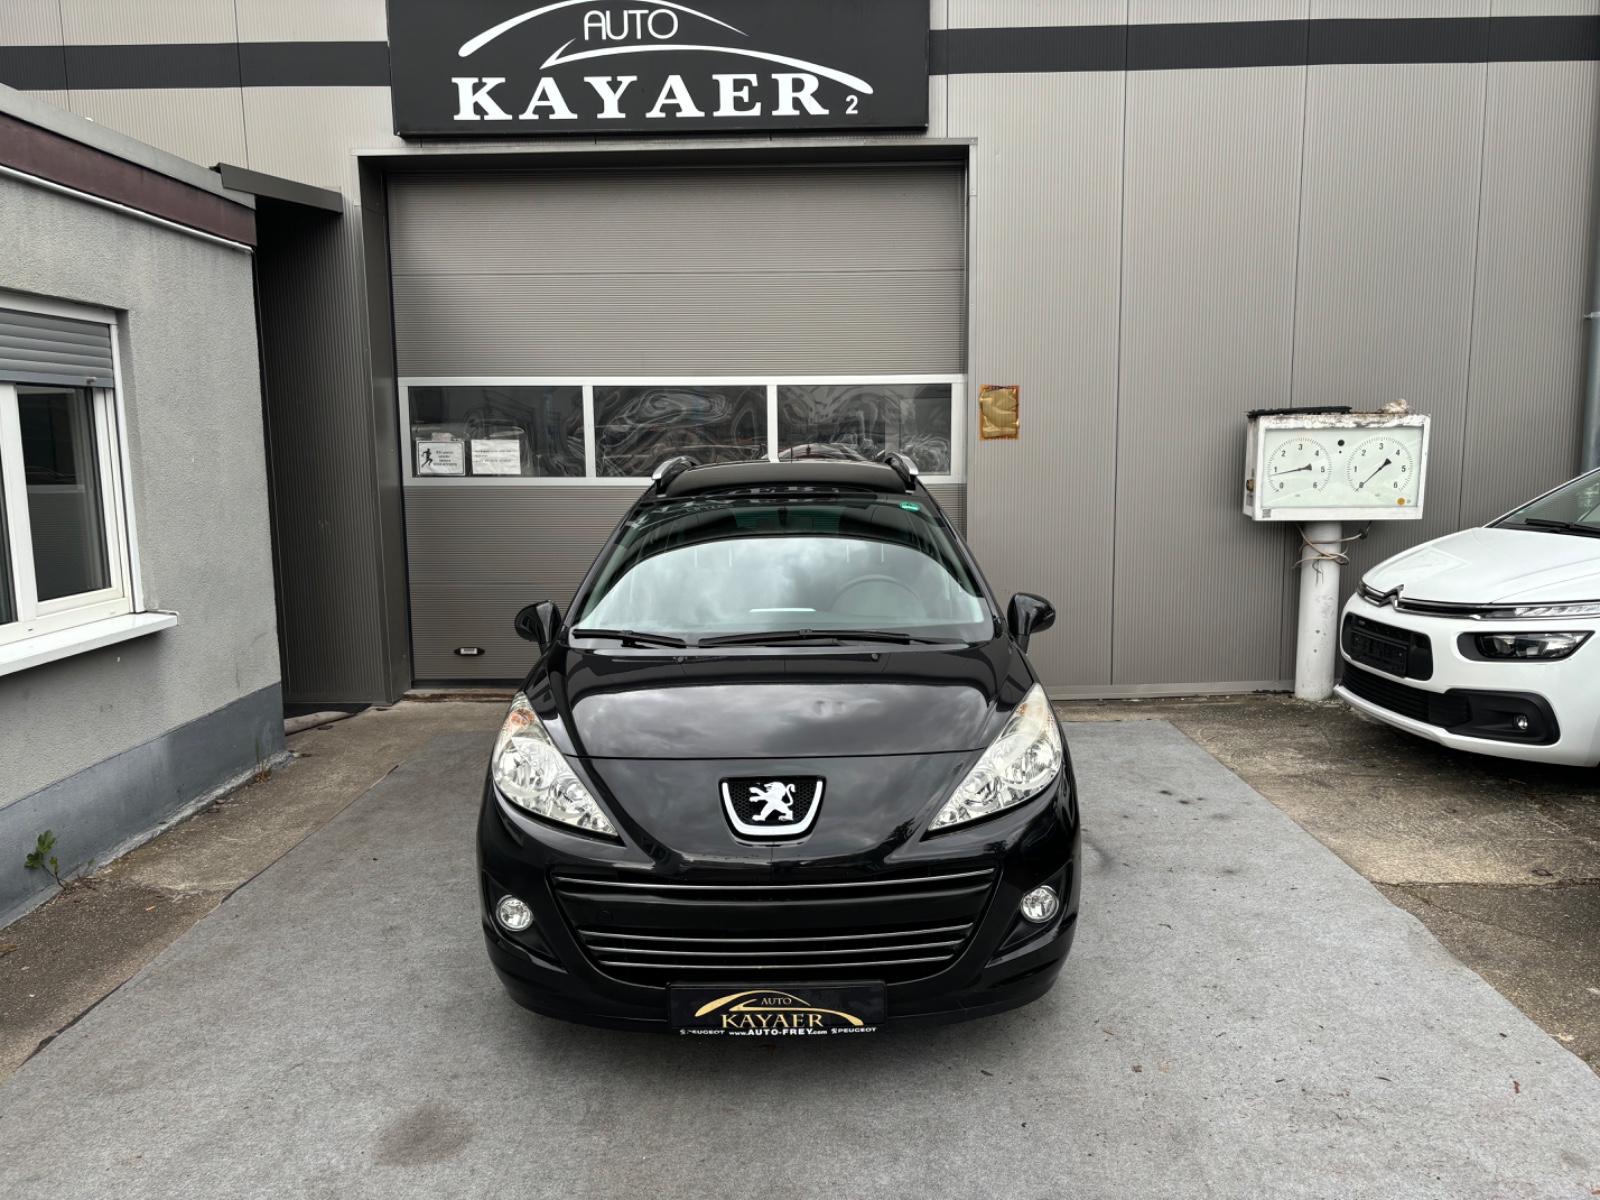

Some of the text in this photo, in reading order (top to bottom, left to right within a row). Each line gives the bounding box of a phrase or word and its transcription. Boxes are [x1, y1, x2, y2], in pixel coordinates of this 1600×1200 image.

[583, 9, 679, 41] AUTO
[450, 72, 859, 121] KAYAER 2
[761, 997, 792, 1006] AUTO
[720, 1013, 824, 1028] KAYAER
